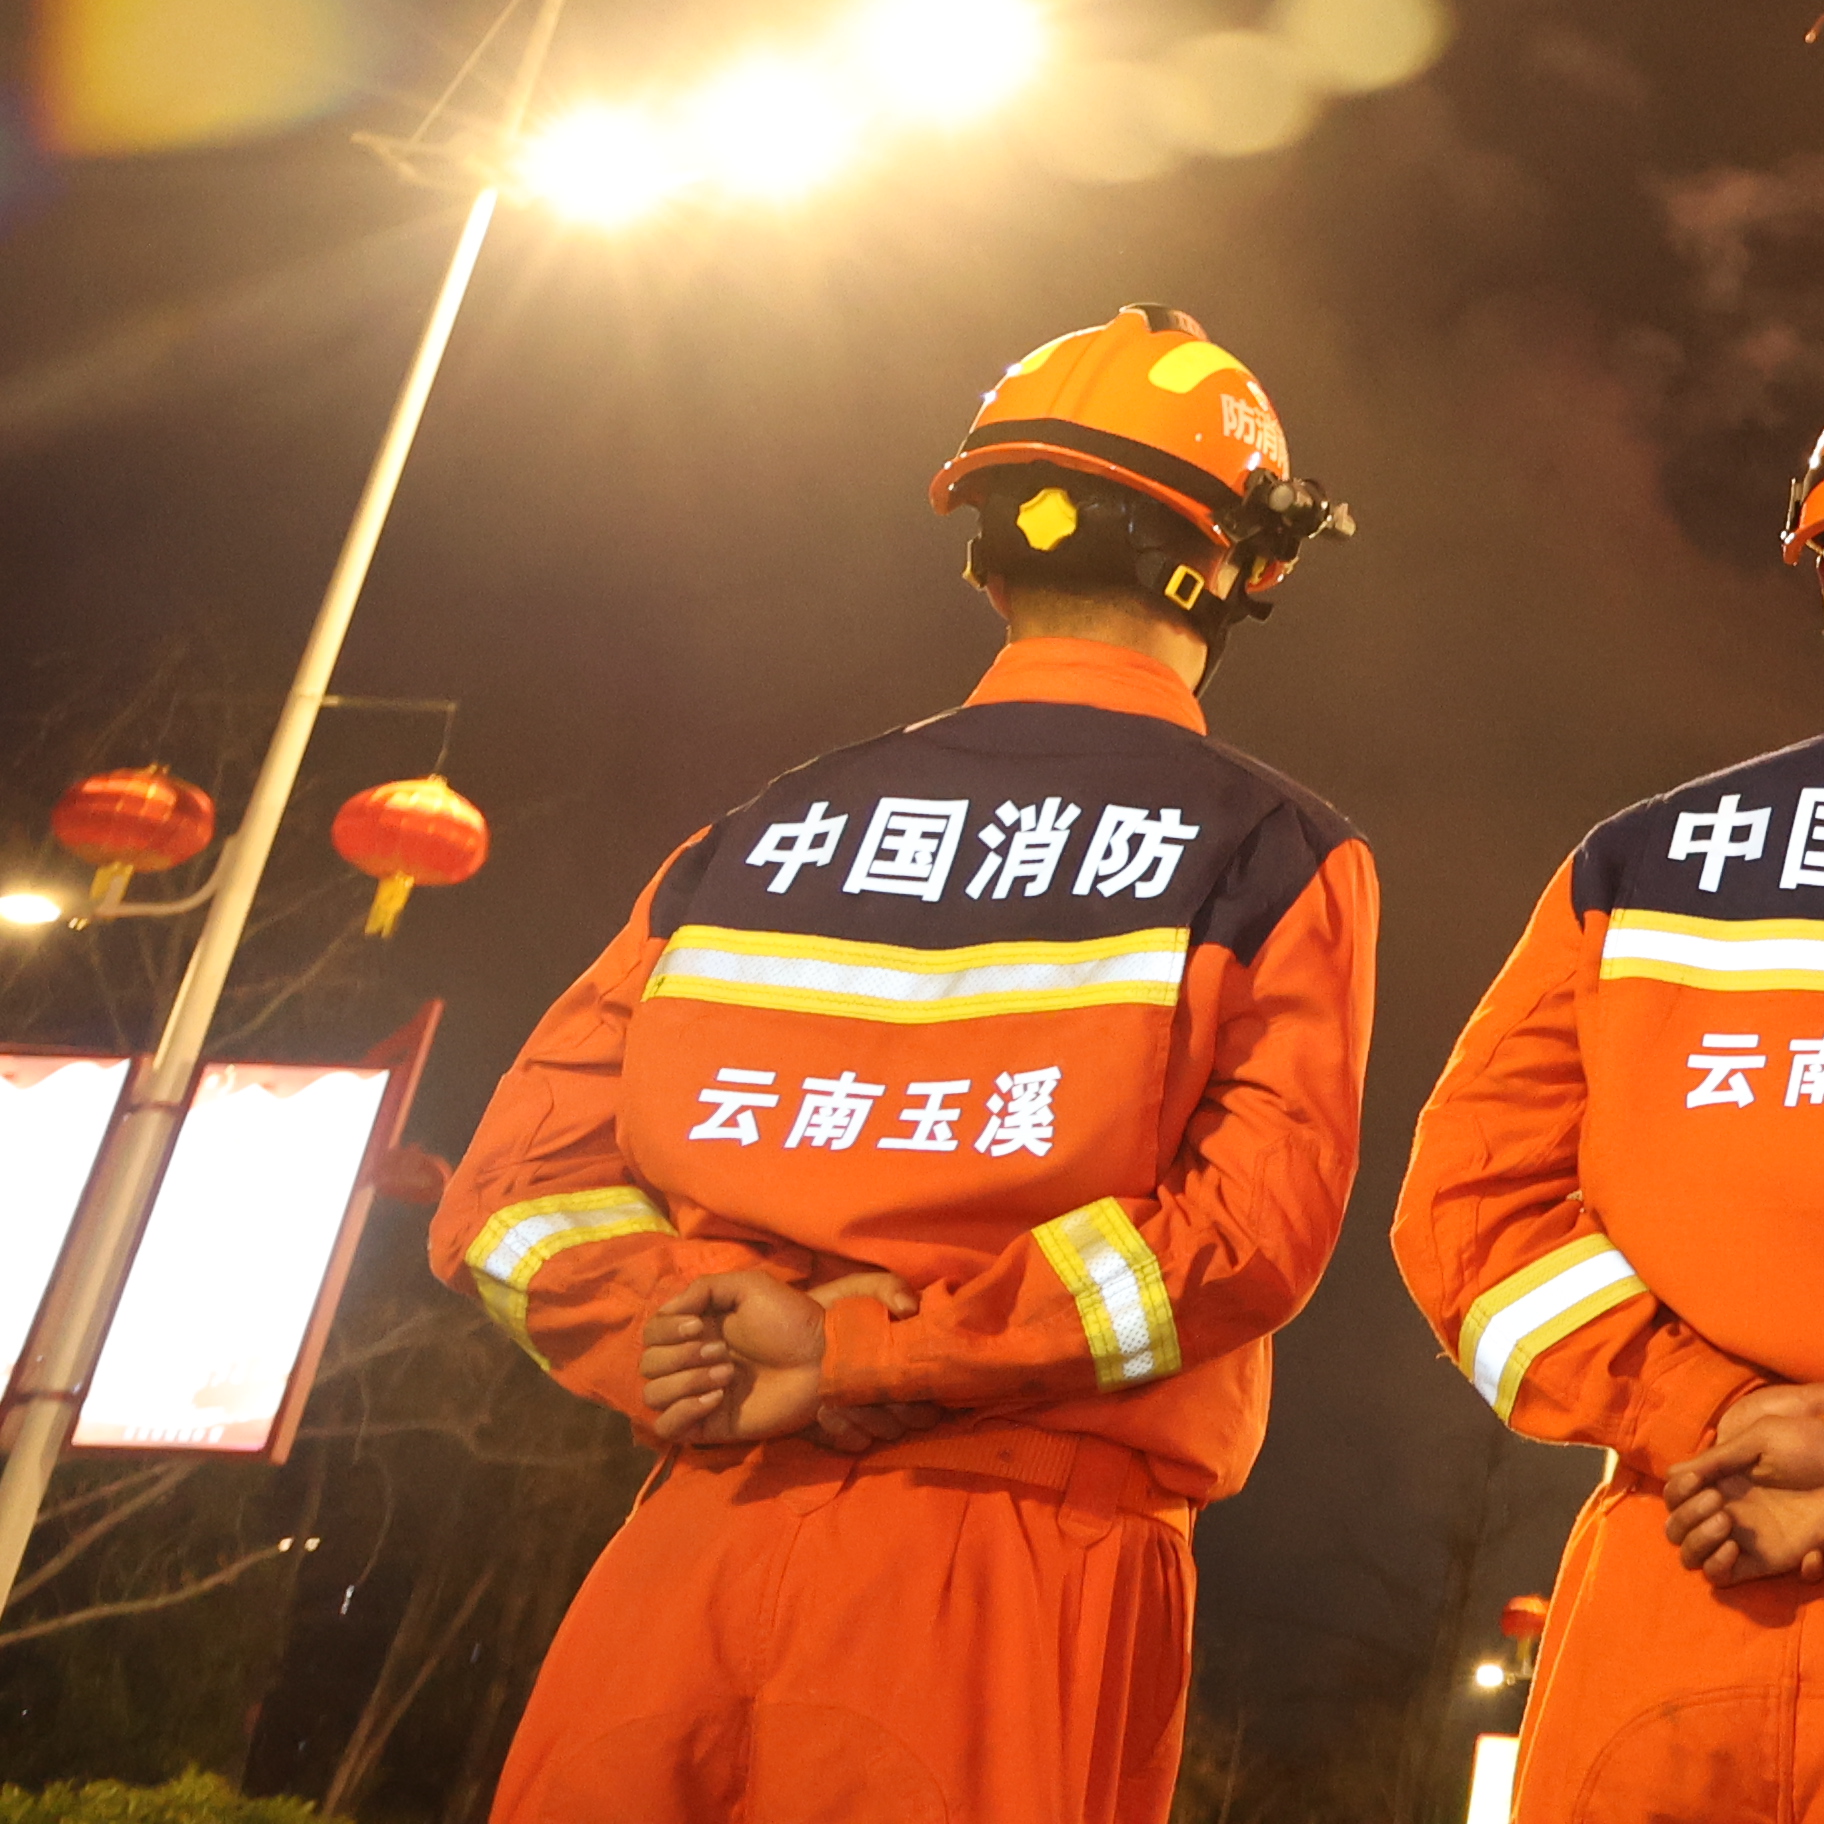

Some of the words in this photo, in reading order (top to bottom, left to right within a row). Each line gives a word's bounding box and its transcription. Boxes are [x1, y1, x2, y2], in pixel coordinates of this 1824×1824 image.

[745, 796, 1200, 902] 中国消防
[688, 1065, 1062, 1158] 云南玉溪
